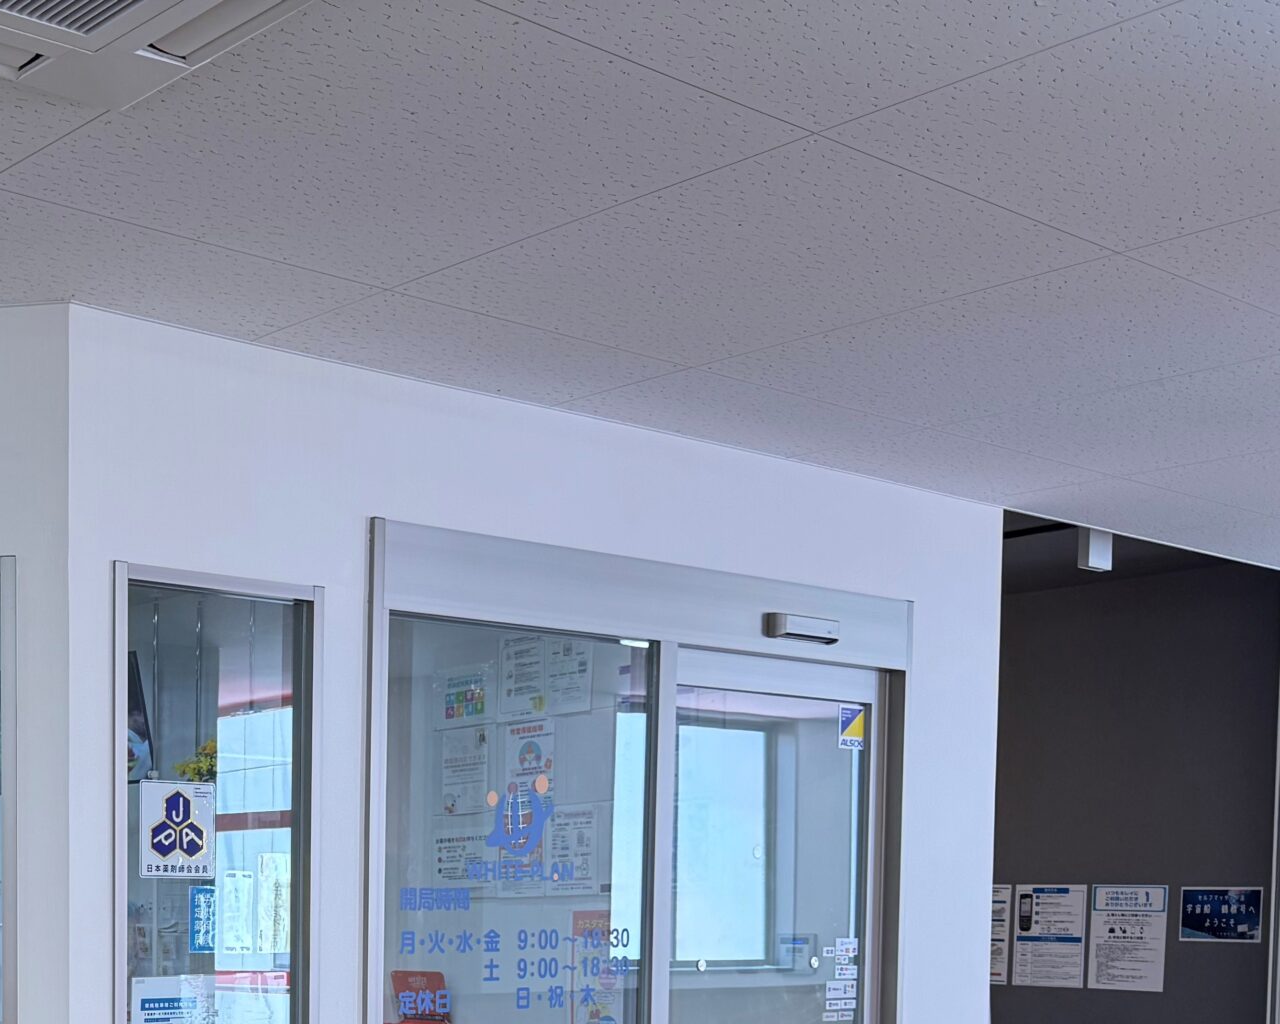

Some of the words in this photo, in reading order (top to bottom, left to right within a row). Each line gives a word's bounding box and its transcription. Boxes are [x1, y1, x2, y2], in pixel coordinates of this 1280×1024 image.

[400, 888, 470, 911] 開局時間
[483, 958, 500, 981] 土
[398, 989, 452, 1015] 定休日
